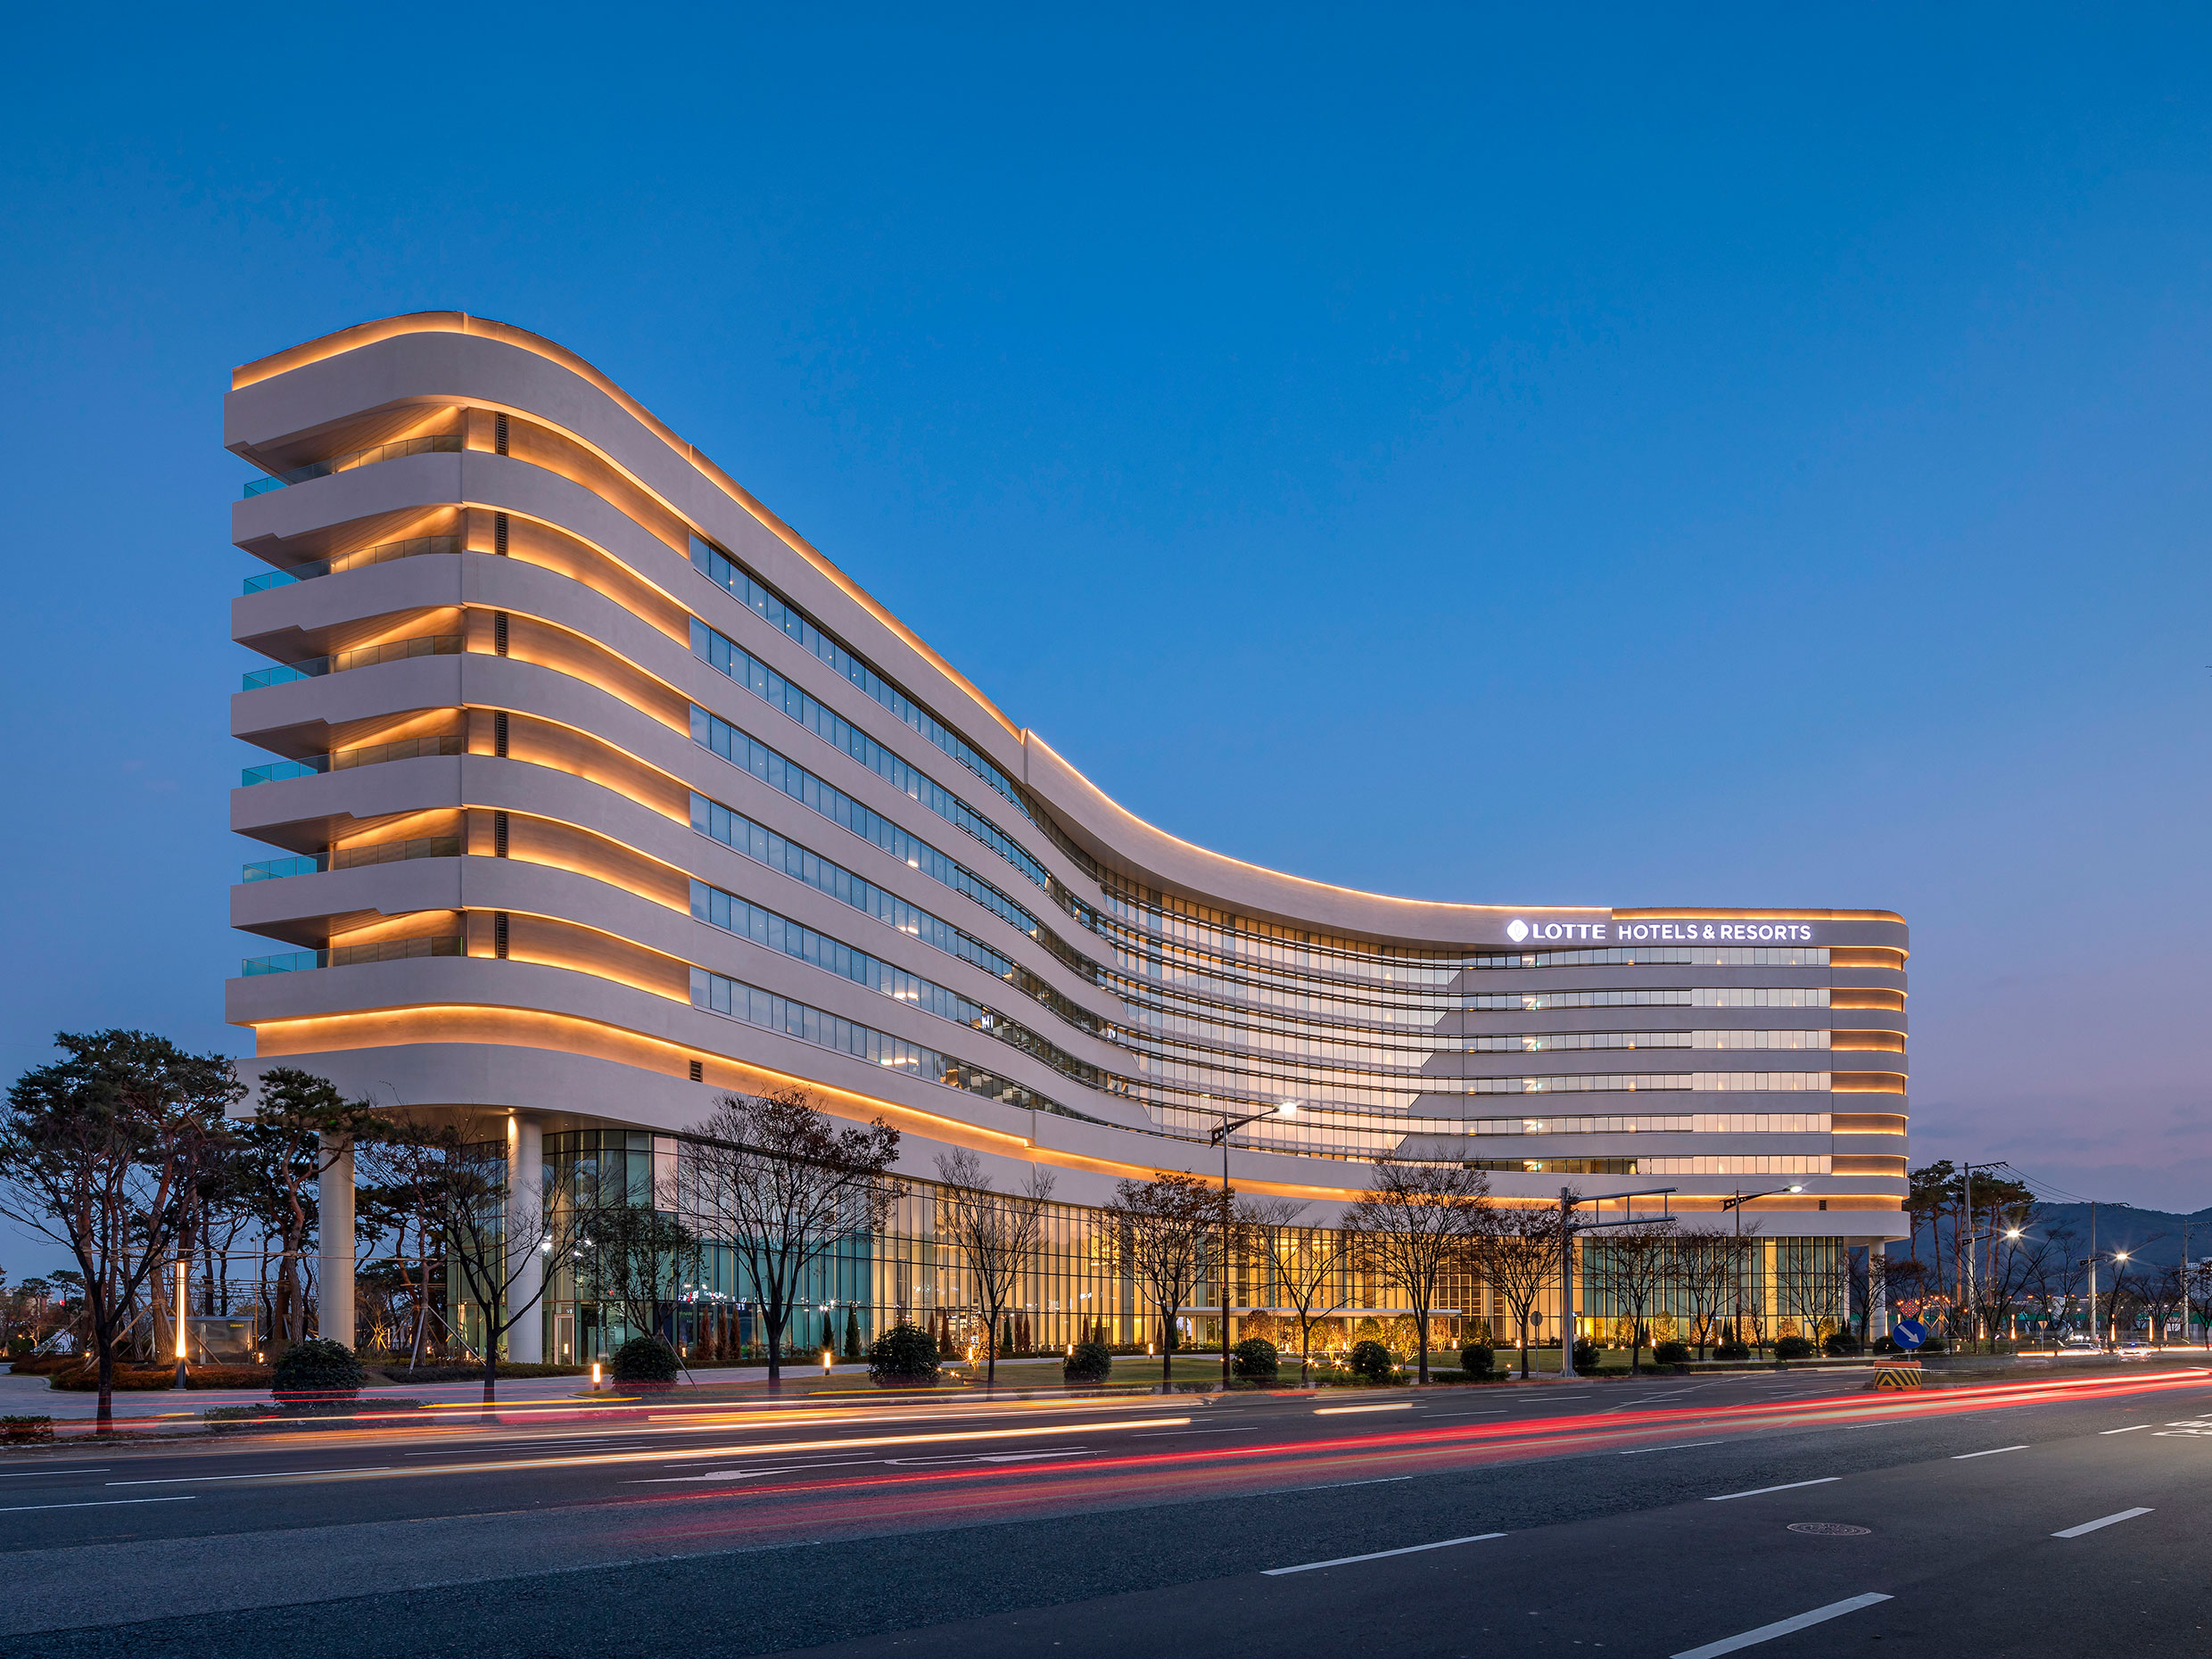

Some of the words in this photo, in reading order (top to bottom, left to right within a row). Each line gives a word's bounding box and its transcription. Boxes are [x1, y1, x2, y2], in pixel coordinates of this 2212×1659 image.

[1532, 922, 1606, 939] LOTTE
[1618, 923, 1698, 940] HOTELS
[1702, 923, 1715, 940] &
[1720, 924, 1812, 940] RESORTS
